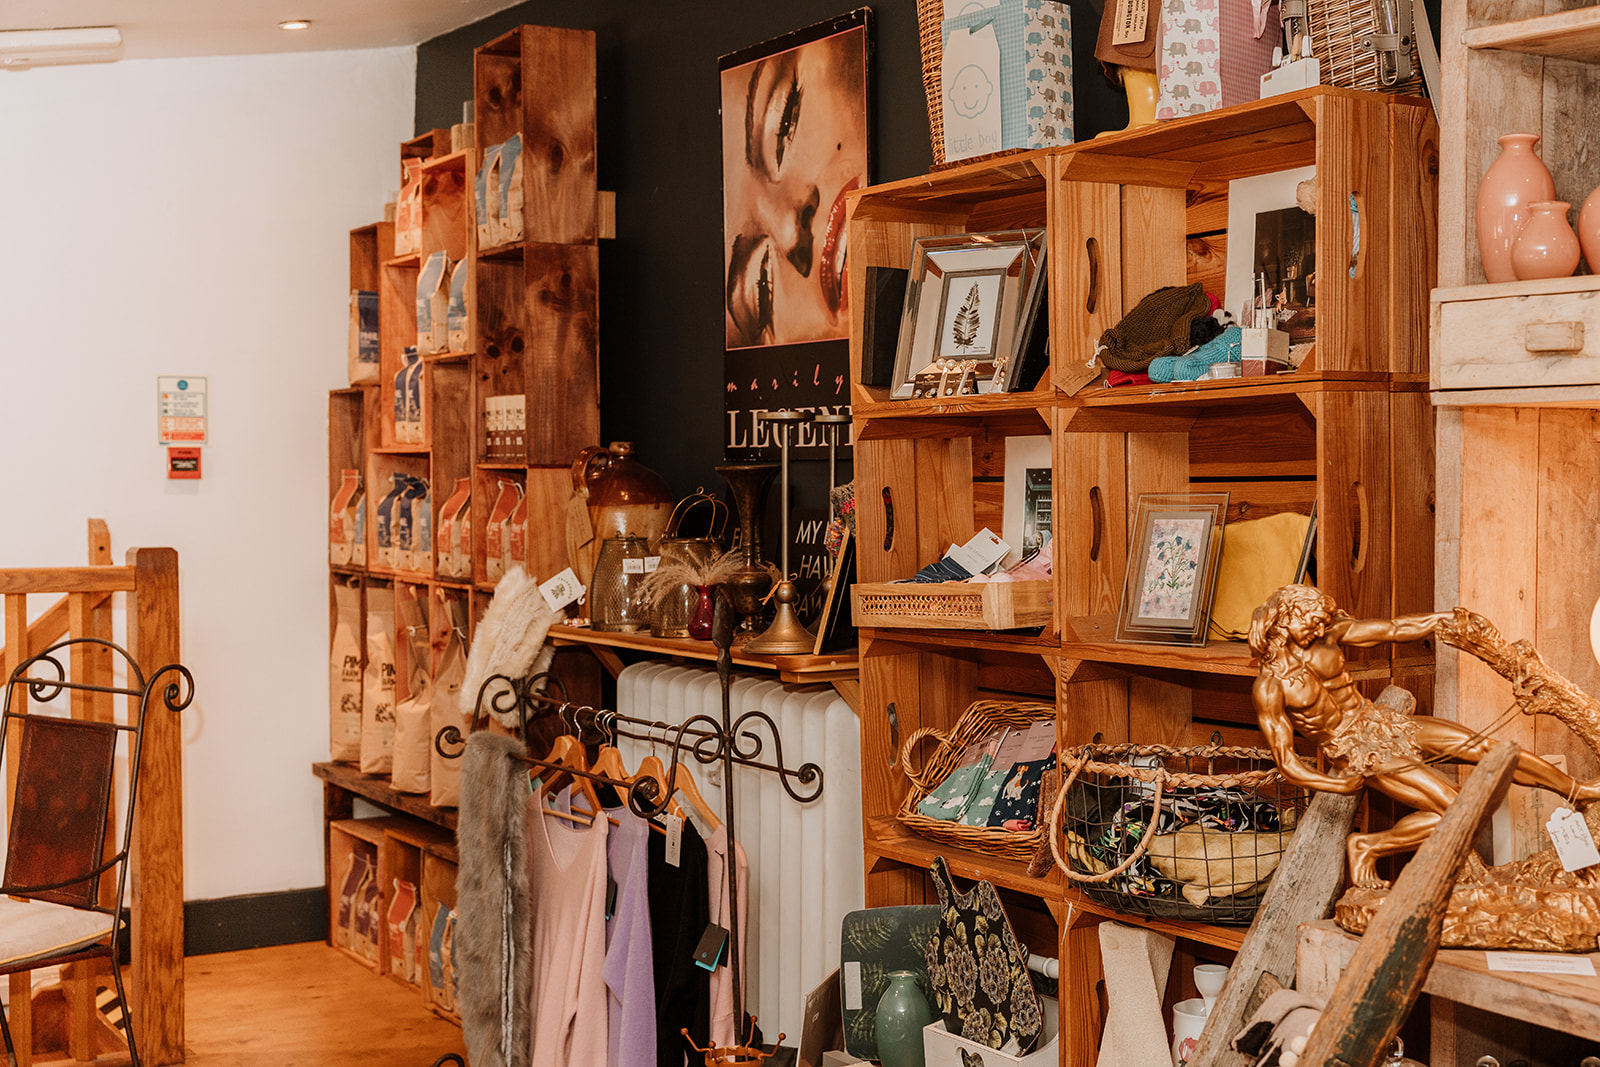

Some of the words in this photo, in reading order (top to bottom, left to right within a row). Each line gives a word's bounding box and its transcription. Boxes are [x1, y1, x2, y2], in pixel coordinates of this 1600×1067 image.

[948, 132, 974, 154] little
[977, 129, 998, 150] boy
[727, 405, 854, 448] LEGEN
[795, 520, 823, 545] MY
[799, 555, 831, 580] HAV
